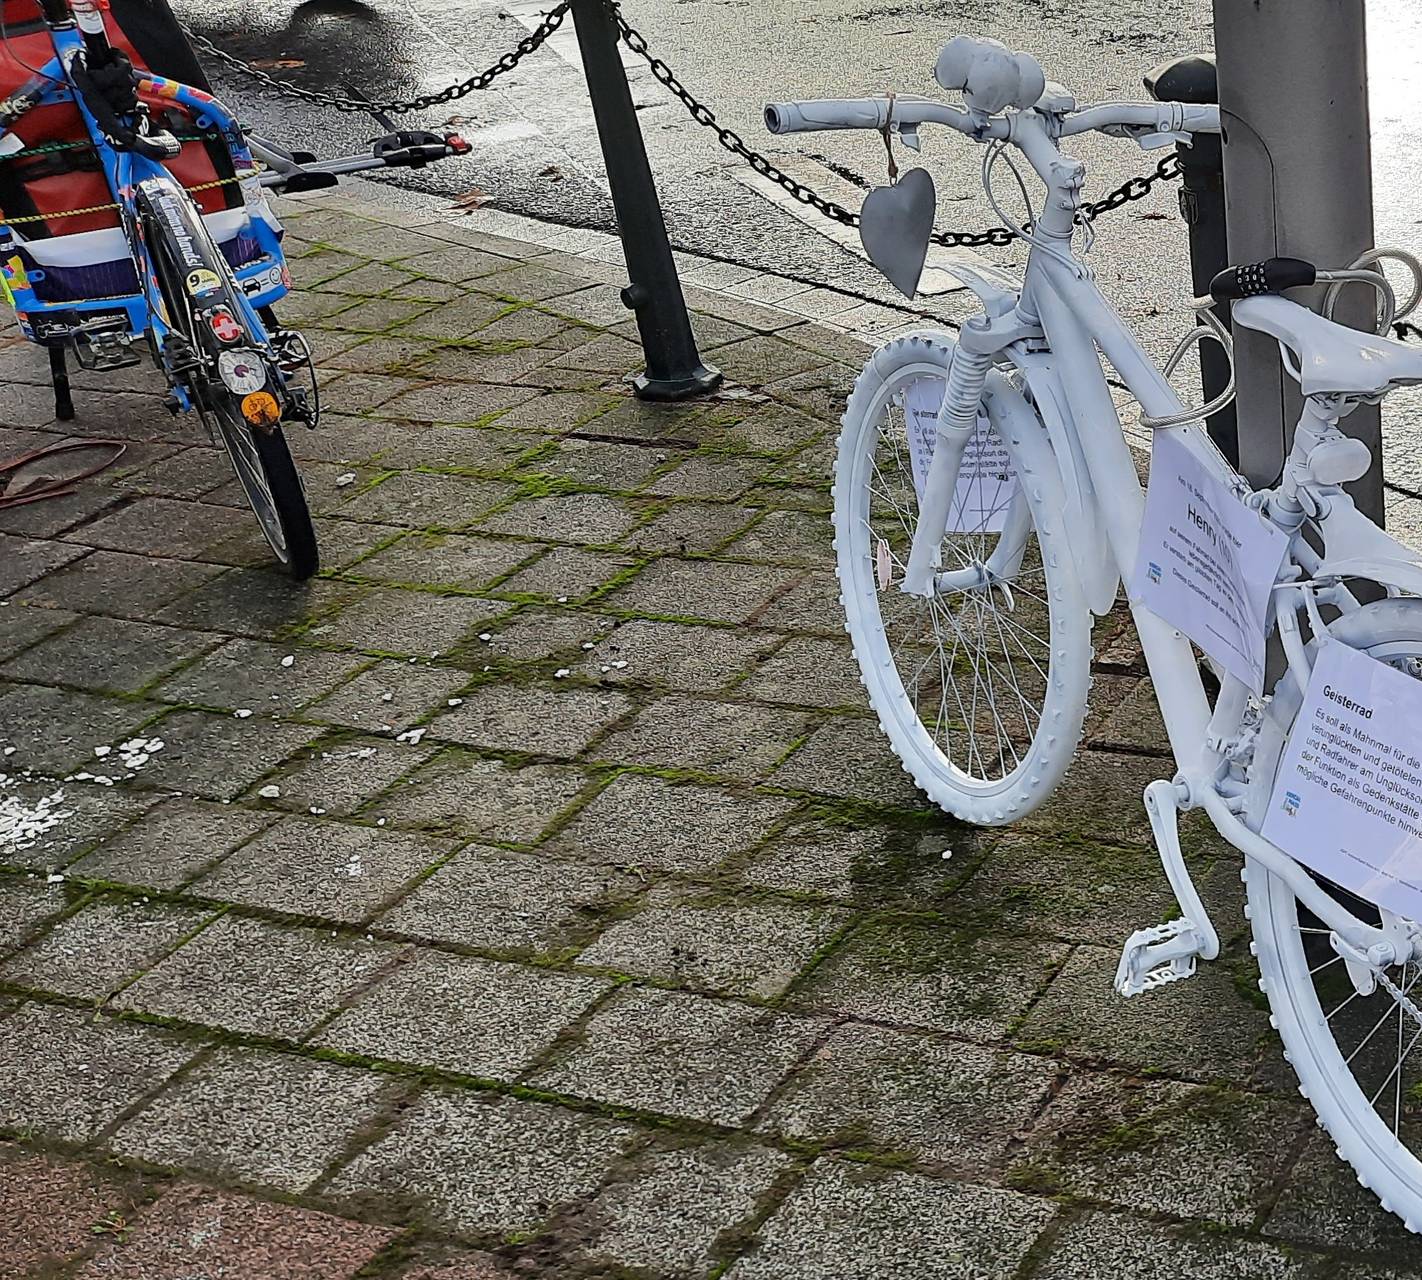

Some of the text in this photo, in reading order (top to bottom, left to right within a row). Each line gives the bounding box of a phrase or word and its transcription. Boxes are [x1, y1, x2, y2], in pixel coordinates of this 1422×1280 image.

[176, 235, 203, 267] hands!
[190, 274, 200, 287] 9
[1188, 504, 1216, 546] Henry
[1324, 685, 1373, 719] Geisterrad
[1306, 737, 1320, 750] und
[1320, 743, 1359, 771] Radfahrer
[1360, 768, 1374, 780] am
[1312, 723, 1361, 756] verunglückten
[1363, 752, 1381, 766] und
[1380, 762, 1422, 788] getöteten
[1316, 708, 1325, 720] Es
[1325, 715, 1339, 727] soll
[1339, 723, 1351, 734] als
[1353, 728, 1392, 754] Mahnmal
[1393, 748, 1405, 762] für
[1407, 757, 1420, 769] die
[1297, 764, 1328, 788] mögliche
[1330, 783, 1396, 824] Gefahrenpunkte
[1301, 750, 1314, 761] der
[1314, 756, 1346, 782] Funktion
[1347, 777, 1360, 789] als
[1363, 783, 1419, 819] Gedenkstätte
